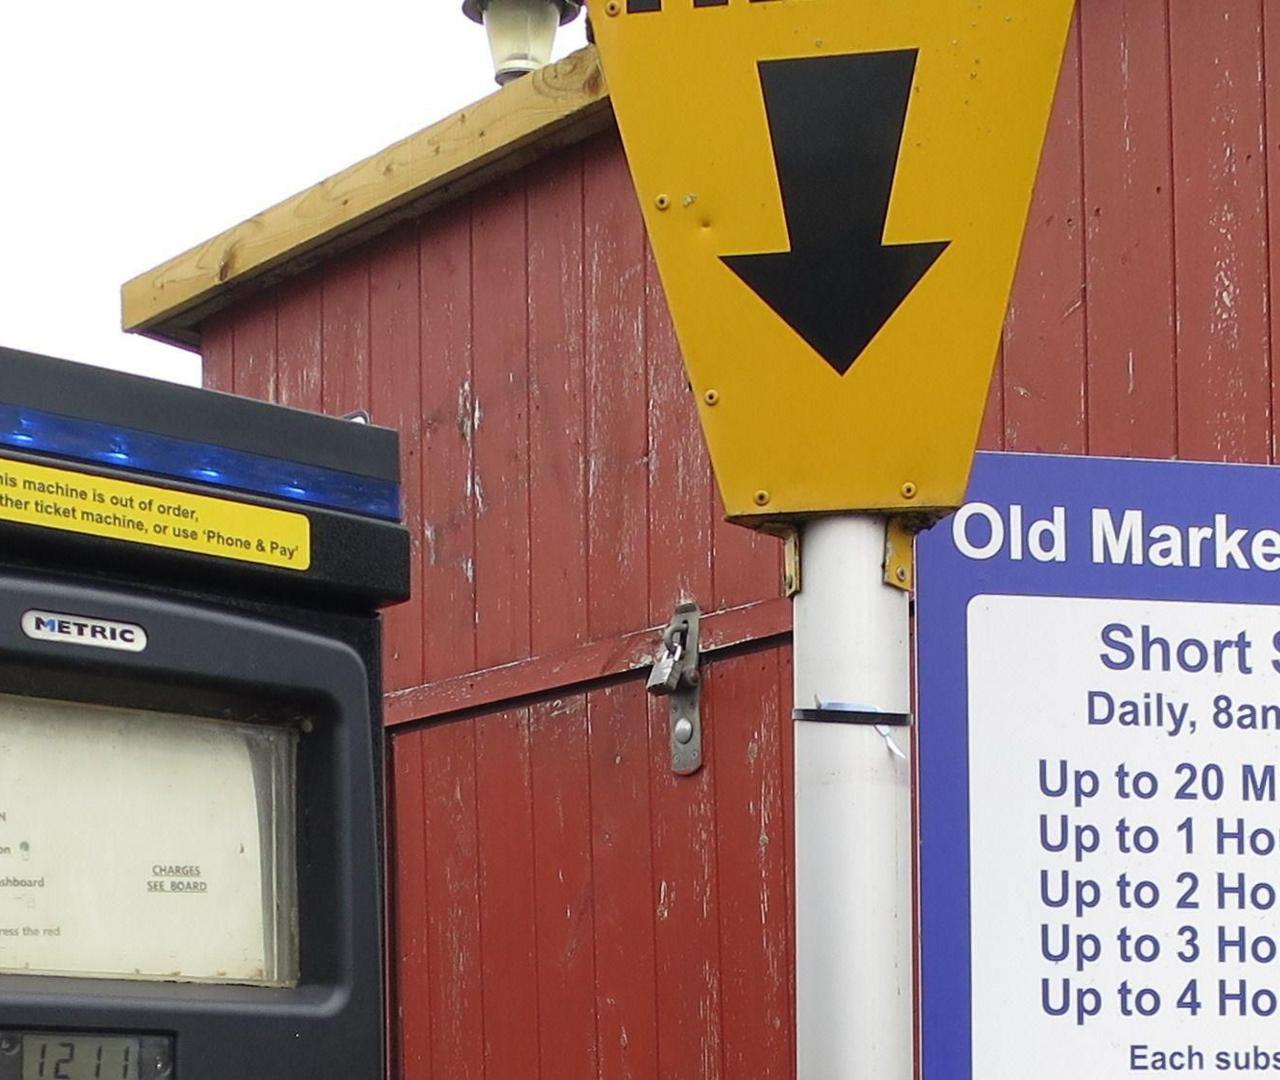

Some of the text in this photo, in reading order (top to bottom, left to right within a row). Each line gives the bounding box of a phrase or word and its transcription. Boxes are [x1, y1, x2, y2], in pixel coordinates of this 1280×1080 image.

[22, 479, 88, 500] machine
[92, 488, 105, 503] is
[109, 495, 134, 509] out
[138, 498, 153, 512] of
[157, 504, 198, 522] order,
[34, 499, 77, 520] ticket
[80, 510, 148, 533] machine,
[152, 523, 168, 535] or
[172, 526, 198, 540] use
[255, 538, 266, 552] &
[952, 502, 1065, 561] Old
[34, 616, 140, 642] METRIC
[1099, 622, 1252, 674] Short
[1087, 690, 1196, 736] Daily,
[1039, 759, 1099, 807] Up
[1114, 762, 1158, 799] to
[1174, 762, 1224, 800] 20
[1039, 814, 1100, 862] Up
[1115, 817, 1158, 853] to
[1177, 816, 1192, 854] 1
[146, 880, 208, 894] SEE BOARD
[151, 864, 200, 877] CHARGES
[1040, 869, 1100, 917] Up
[1116, 872, 1159, 908] to
[1176, 871, 1199, 909] 2
[1040, 923, 1101, 971] Up
[1116, 926, 1160, 962] to
[1177, 924, 1200, 963] 3
[1041, 977, 1101, 1025] Up
[1117, 980, 1160, 1016] to
[1176, 978, 1201, 1016] 4
[1130, 1044, 1203, 1070] Each
